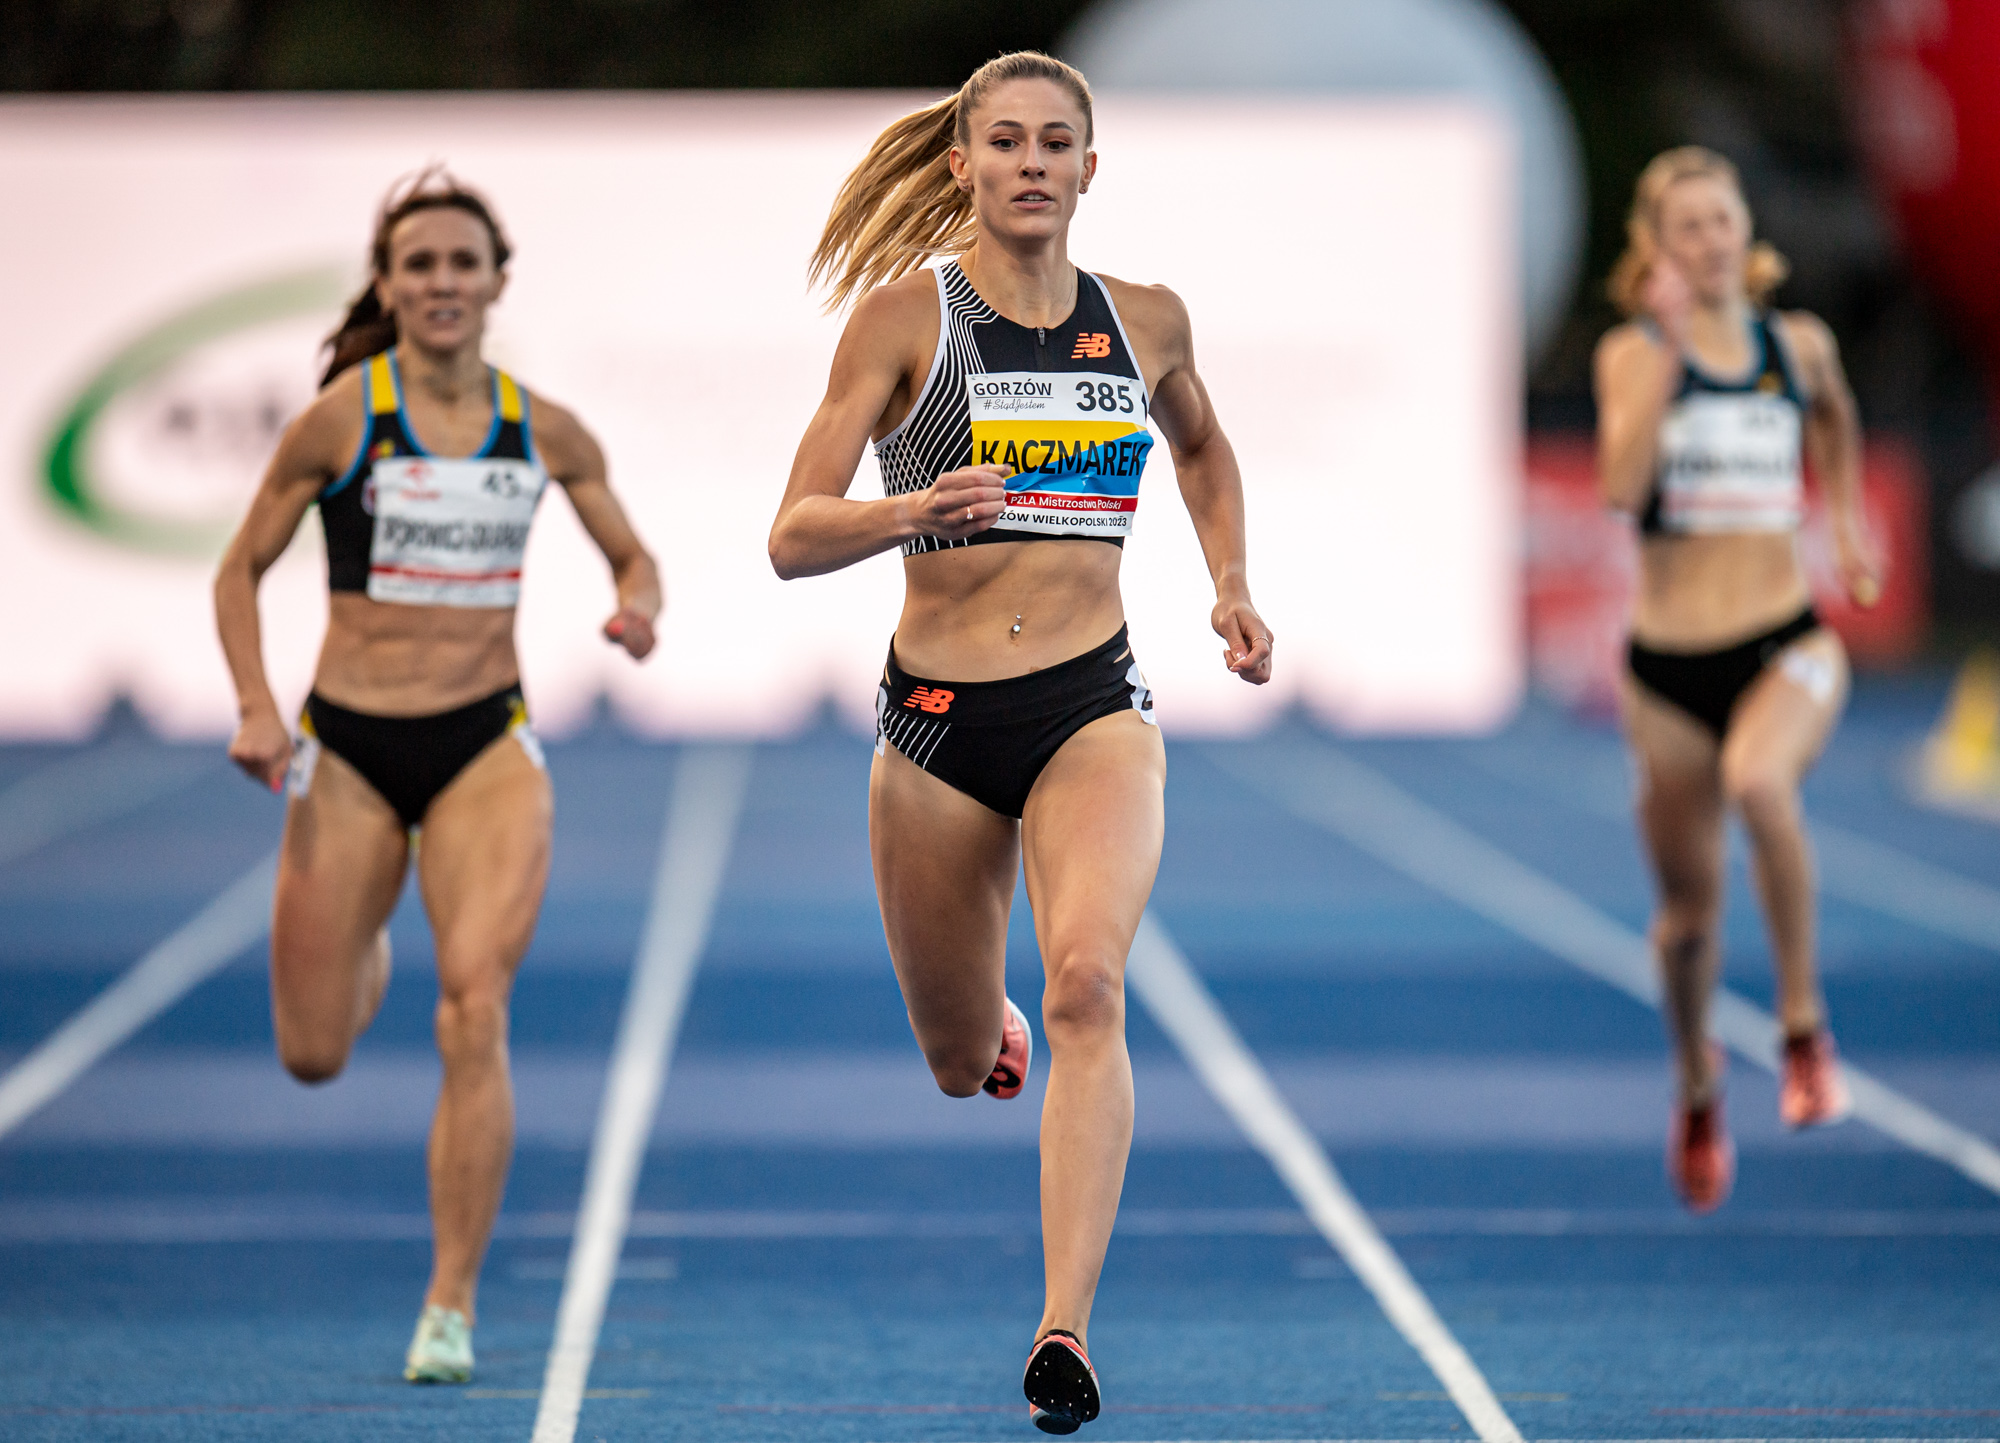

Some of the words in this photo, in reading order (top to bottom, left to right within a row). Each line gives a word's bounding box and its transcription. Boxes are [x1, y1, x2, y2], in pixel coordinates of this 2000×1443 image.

[973, 378, 1052, 396] GORZÓW
[1075, 381, 1134, 413] 385
[980, 439, 1148, 477] KACZMAREK
[1010, 495, 1036, 506] PZLA
[1039, 496, 1097, 509] Mistrzostwa
[1097, 499, 1122, 510] Polski
[999, 510, 1029, 522] ZÓW
[1032, 513, 1108, 527] WIELKOPOLSKI
[1108, 515, 1127, 527] 2023
